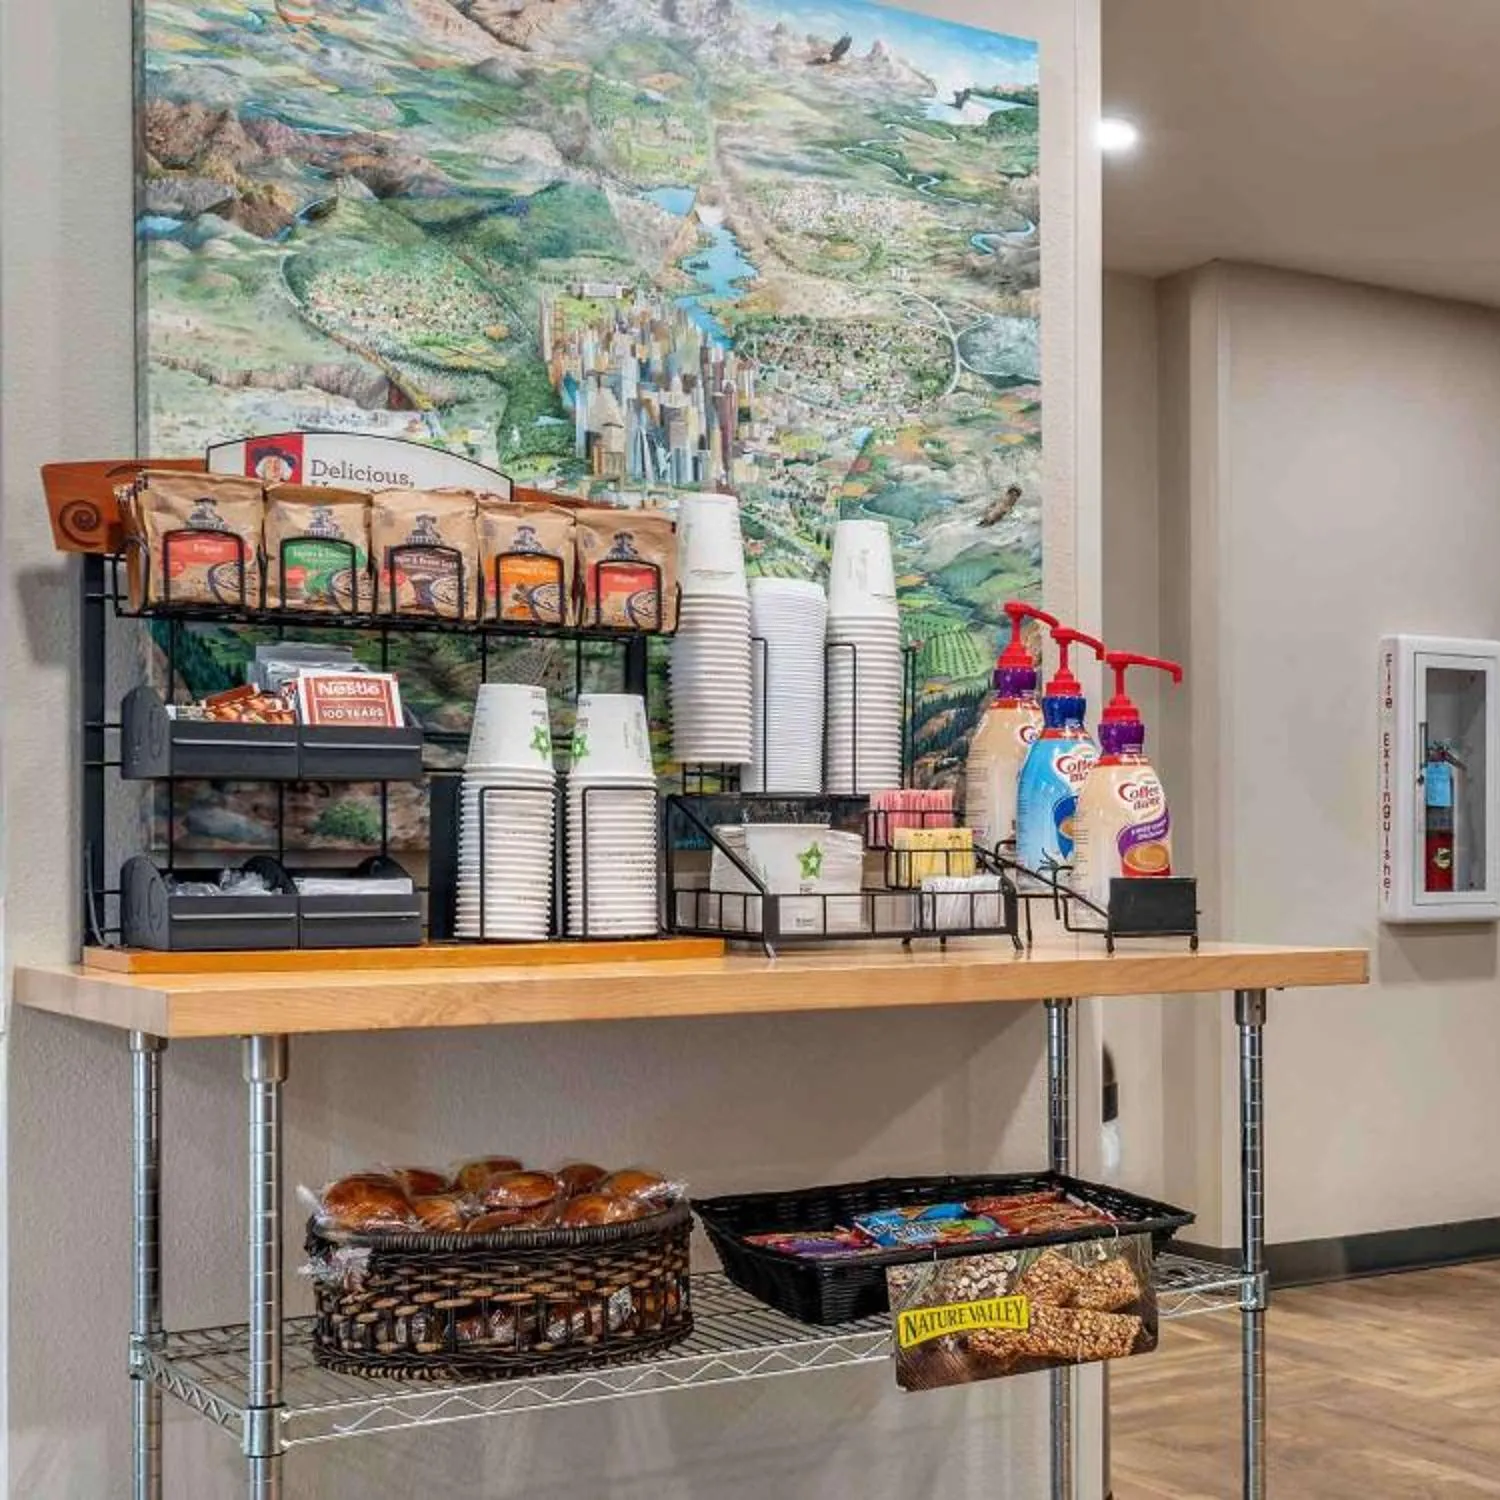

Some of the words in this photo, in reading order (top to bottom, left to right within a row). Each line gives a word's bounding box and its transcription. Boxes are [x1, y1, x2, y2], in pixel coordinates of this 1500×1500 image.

[311, 458, 415, 489] Delicious,
[1384, 652, 1394, 709] Fire
[1118, 782, 1160, 802] Coffee
[1382, 731, 1392, 903] Extinguisher
[905, 1305, 967, 1344] NATURE
[968, 1298, 1024, 1327] VALLEY
